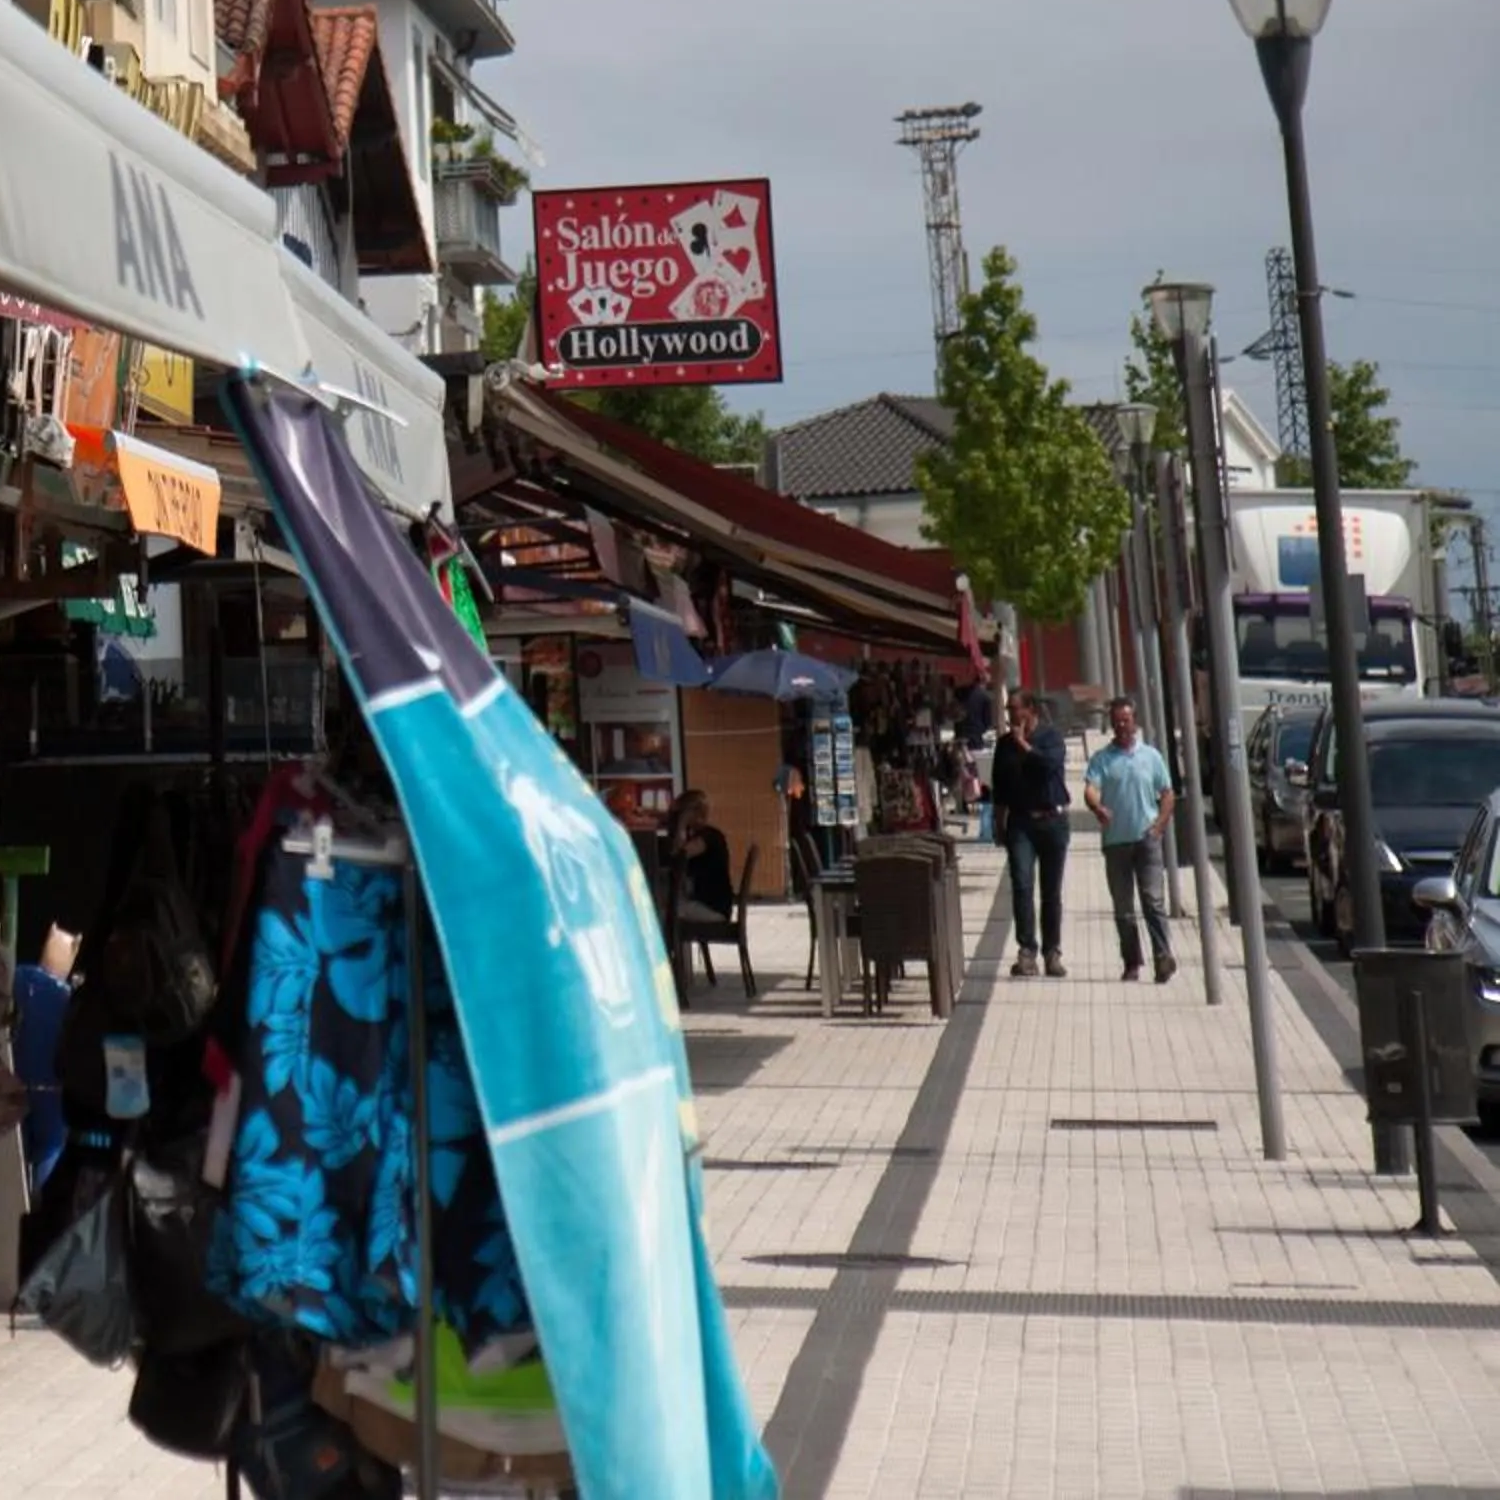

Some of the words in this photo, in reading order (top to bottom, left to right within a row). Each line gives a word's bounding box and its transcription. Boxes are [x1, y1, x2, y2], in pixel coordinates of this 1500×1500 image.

[108, 150, 205, 322] ANA
[556, 213, 656, 252] Salón
[555, 252, 680, 298] Juego
[569, 322, 750, 365] Hollywood
